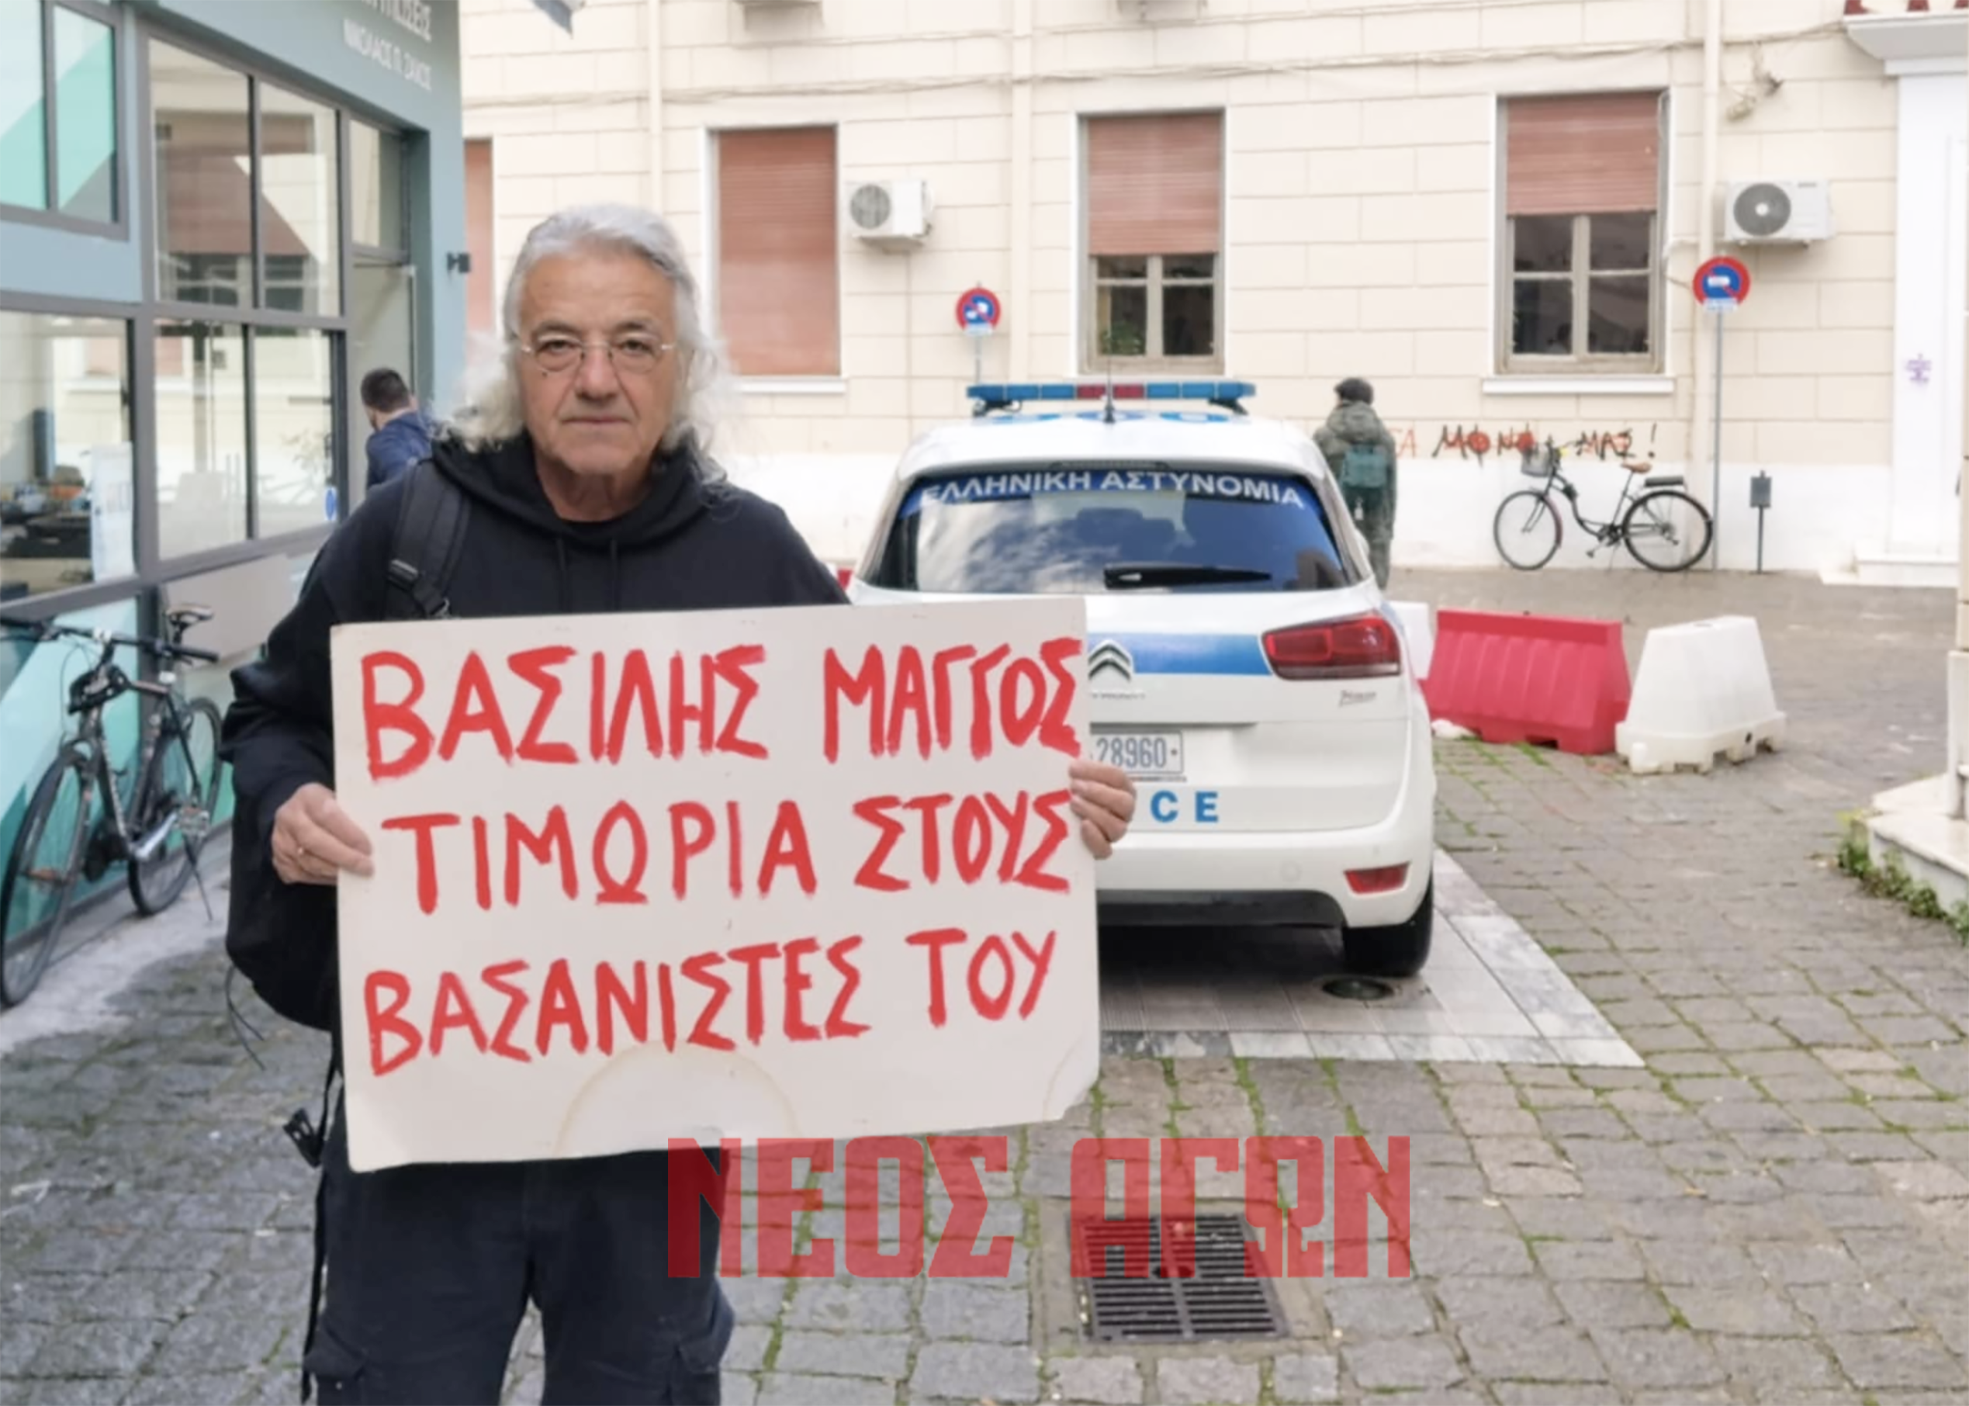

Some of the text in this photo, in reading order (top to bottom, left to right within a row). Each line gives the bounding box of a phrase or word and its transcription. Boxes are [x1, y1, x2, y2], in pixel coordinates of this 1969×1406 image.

[919, 471, 1304, 508] ΕΛΛΗΝΙΚΗ ΑΣΤΥΝΟΜΙΑ
[361, 637, 1082, 782] ΒΑΣΙΛΗΣ ΜΑΓΓΟΣ
[381, 789, 1073, 914] ΤΙΜΩΡΙΑ ΣΤΟΥΣ
[363, 928, 1058, 1077] ΒΑΣΑΝΙΣΤΕΣ ΤΟΥ
